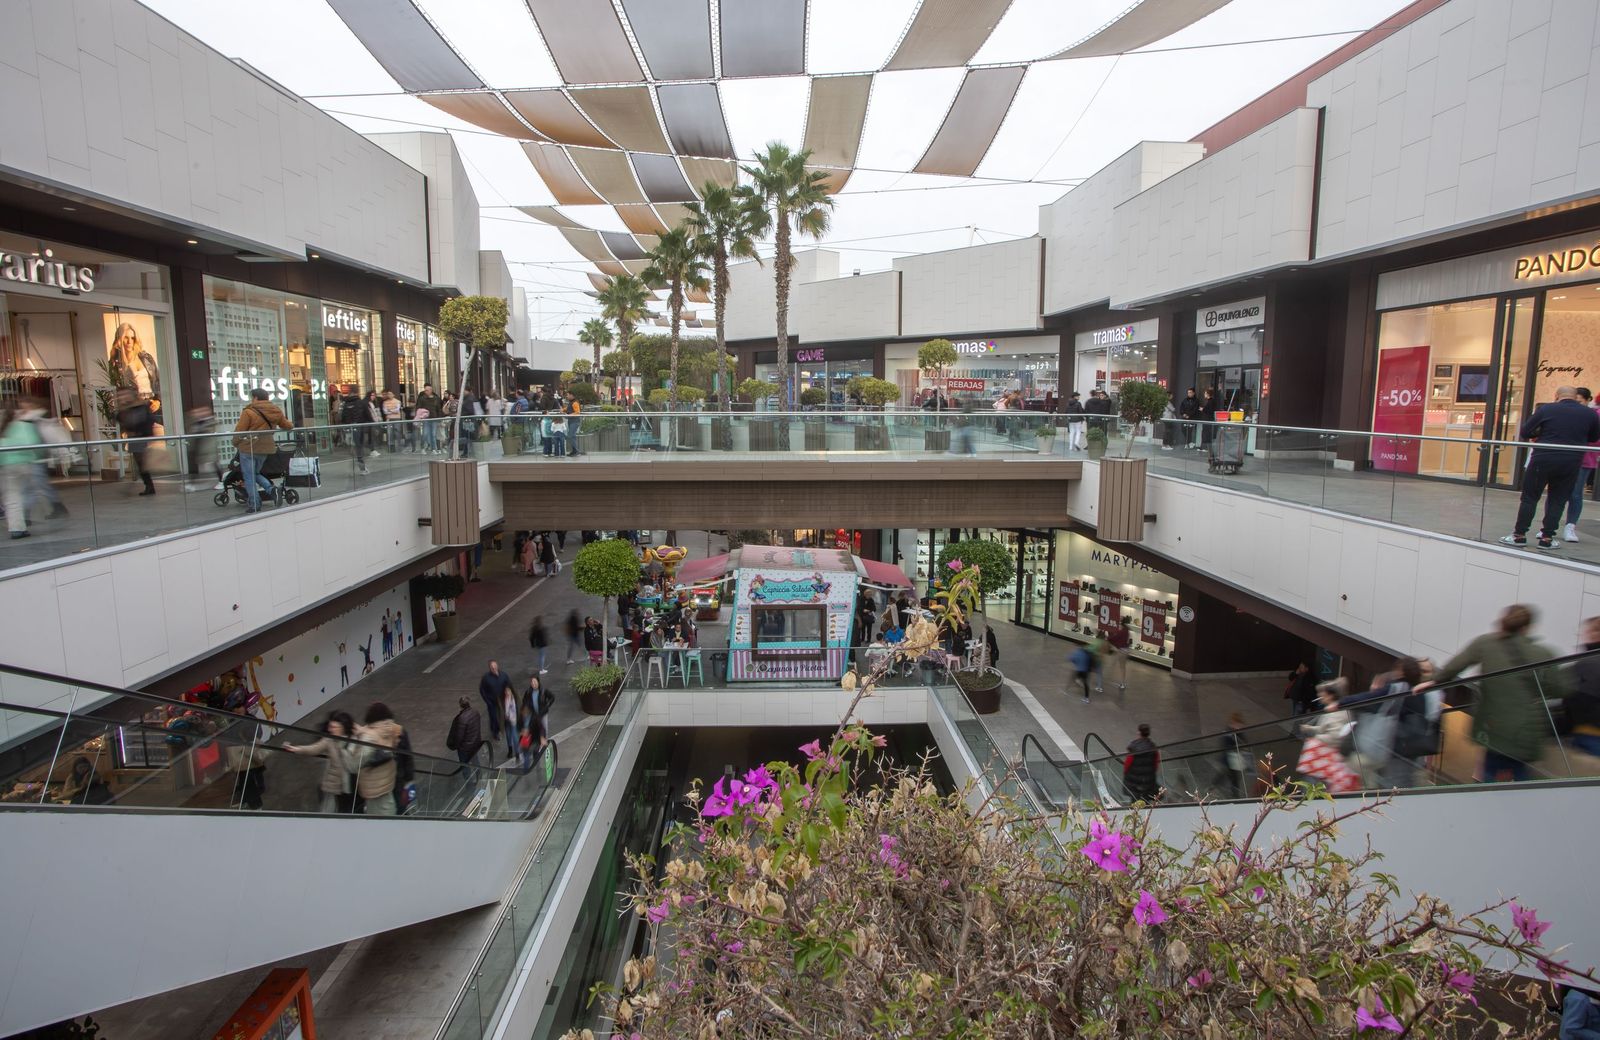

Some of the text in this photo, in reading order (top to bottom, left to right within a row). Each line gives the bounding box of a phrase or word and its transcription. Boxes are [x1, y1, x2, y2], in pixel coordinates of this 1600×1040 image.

[323, 307, 368, 333] lefties
[797, 348, 824, 361] GAME
[1536, 360, 1584, 377] Engraving
[948, 381, 984, 390] REBAJAS
[1382, 389, 1422, 407] -50%
[1380, 452, 1408, 461] PANDORA
